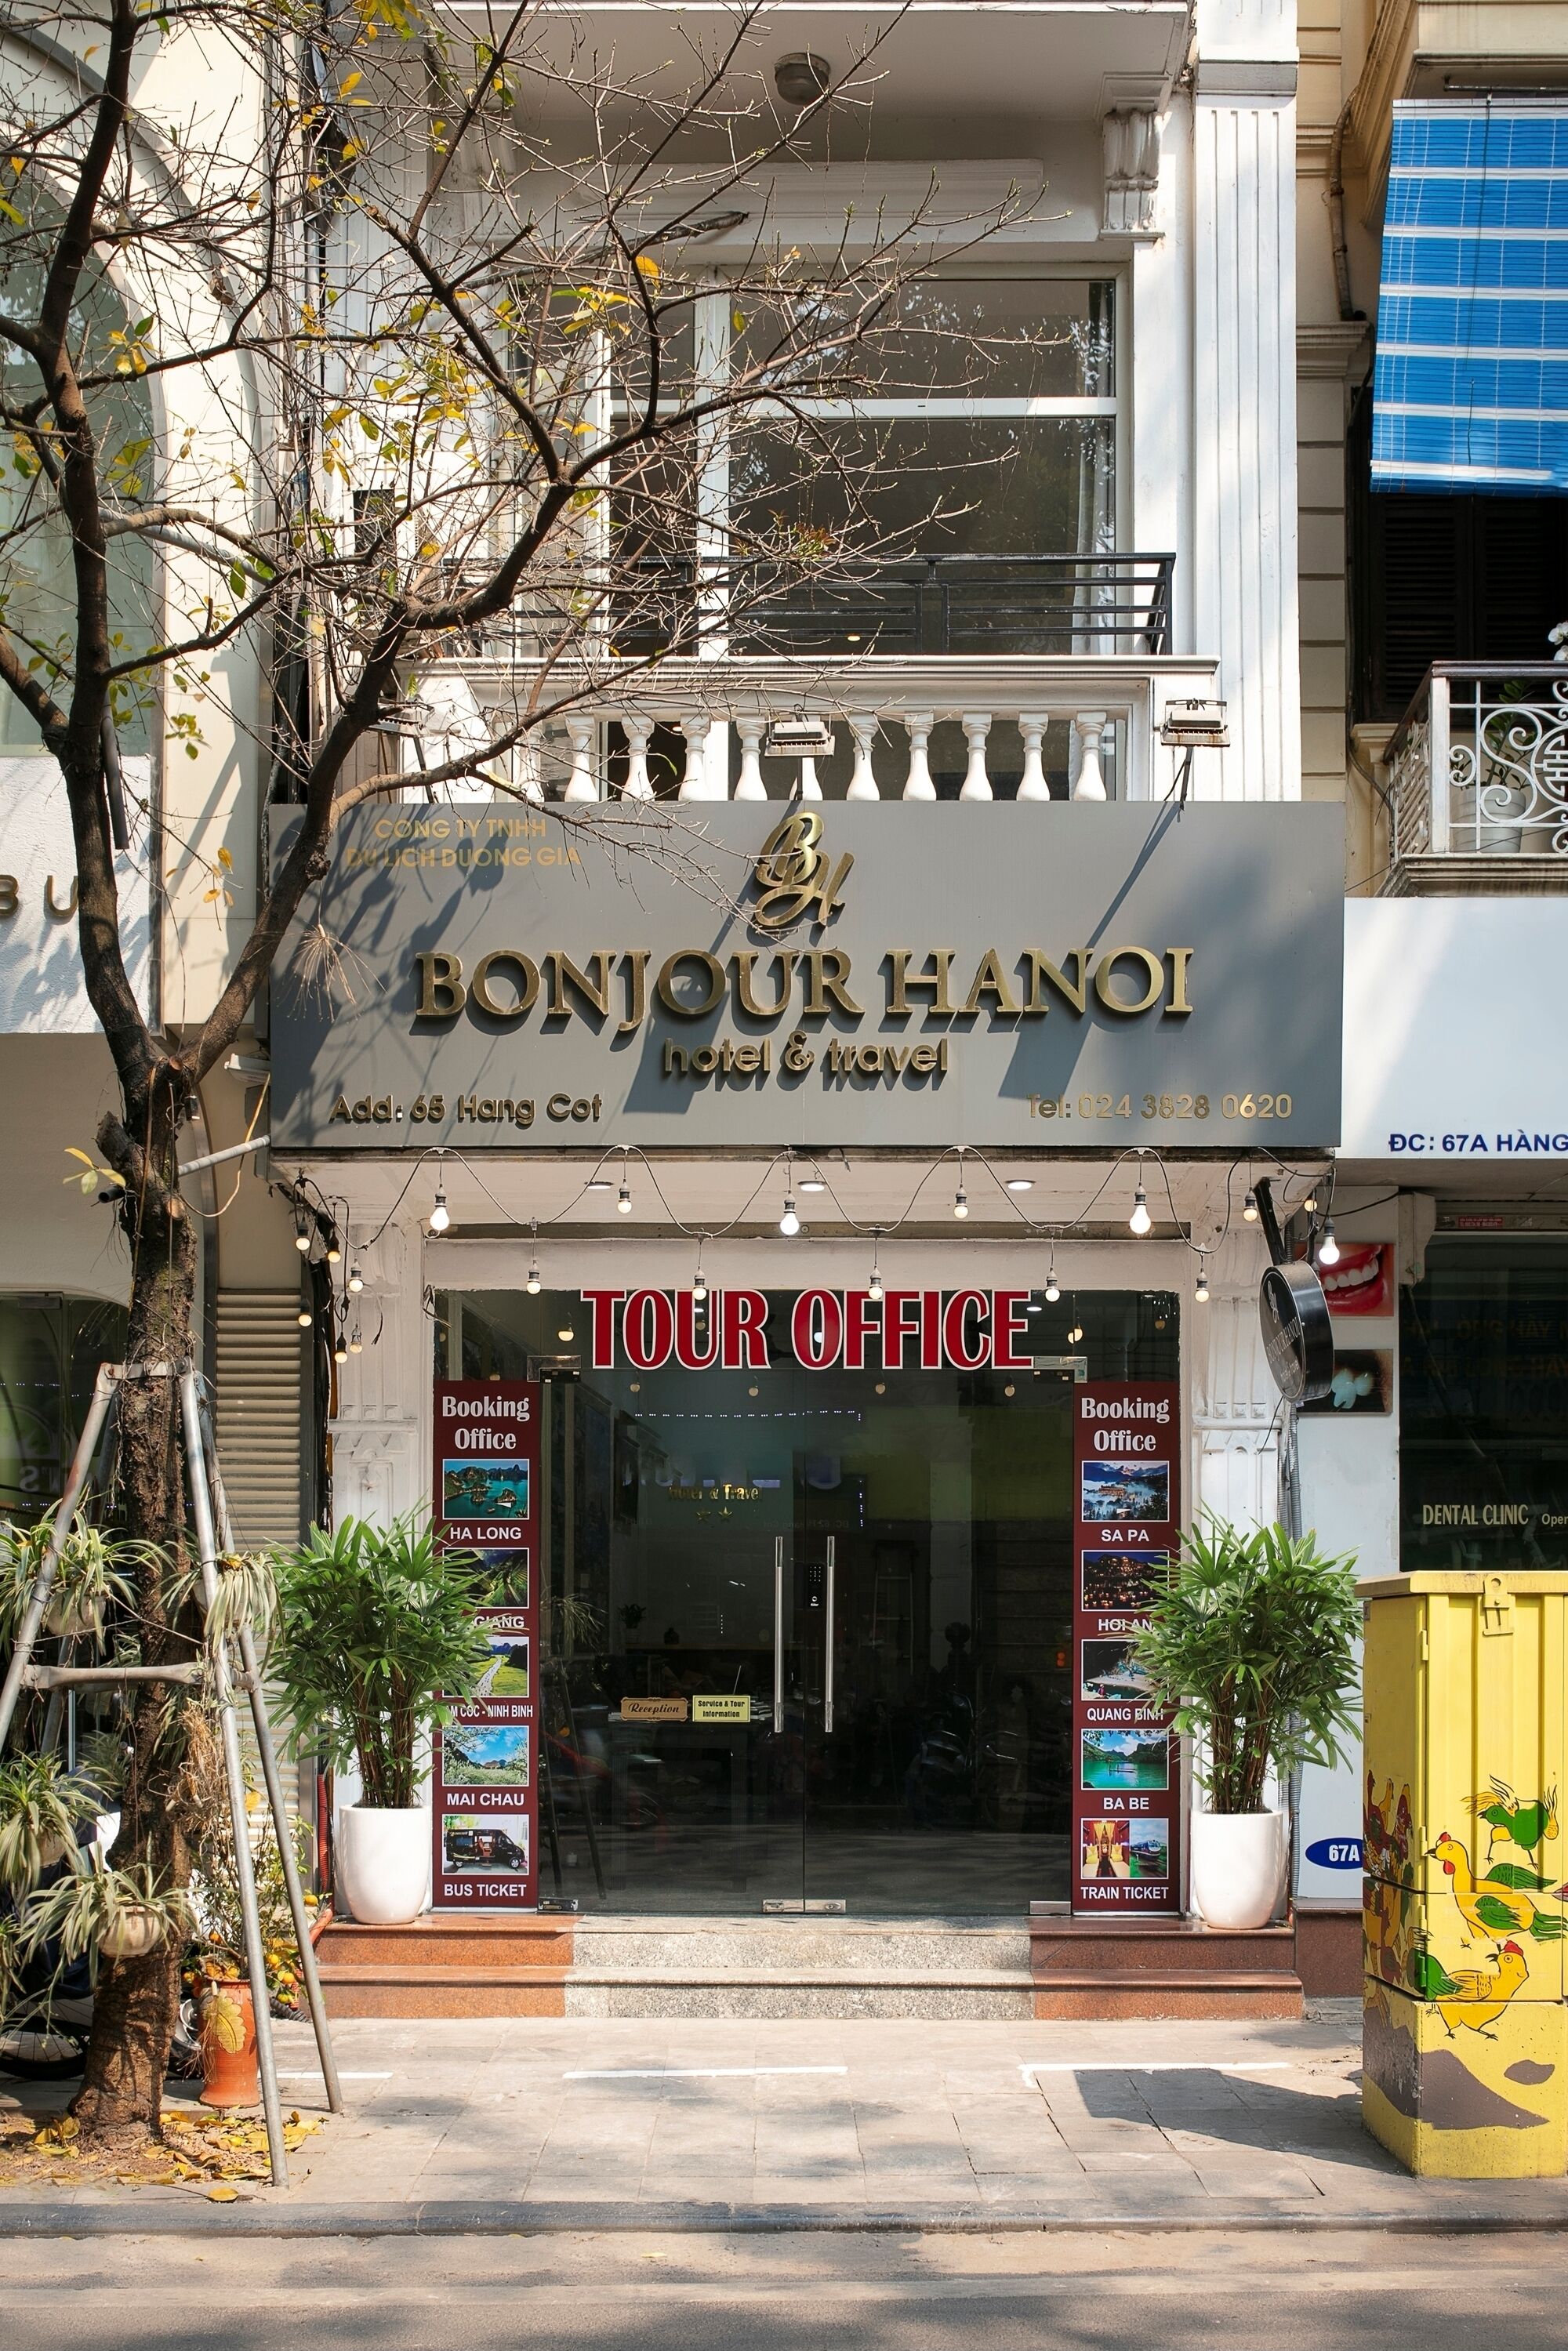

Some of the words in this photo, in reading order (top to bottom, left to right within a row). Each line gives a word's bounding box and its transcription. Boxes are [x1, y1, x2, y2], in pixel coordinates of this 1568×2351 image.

[485, 819, 546, 838] TNHH
[536, 847, 582, 867] GIA
[415, 949, 866, 1032] BONJOUR
[885, 947, 1194, 1014] HANOI
[663, 1037, 771, 1072] hotel
[784, 1030, 815, 1072] &
[829, 1037, 949, 1074] travel
[329, 1094, 403, 1123] Add:
[409, 1094, 445, 1121] 65
[458, 1094, 536, 1127] Hang
[547, 1094, 602, 1121] Cot
[1027, 1094, 1072, 1119] Tel:
[1078, 1094, 1133, 1119] 024
[1140, 1094, 1210, 1119] 3828
[1221, 1094, 1293, 1119] 0620
[1442, 1134, 1488, 1152] 67A
[1496, 1129, 1568, 1152] HÀNG
[580, 1288, 772, 1370] TOUR
[790, 1288, 1035, 1370] OFFICE
[442, 1395, 531, 1422] Booking
[1081, 1397, 1170, 1424] Booking
[455, 1428, 517, 1449] Office
[1094, 1430, 1156, 1451] Office
[1423, 1504, 1478, 1525] DENTAL
[1483, 1504, 1529, 1525] CLINIC
[450, 1527, 472, 1540] HA
[477, 1527, 521, 1540] LONG
[1101, 1529, 1123, 1542] SA
[1127, 1529, 1149, 1542] PA
[1098, 1619, 1126, 1631] HOI
[487, 1704, 509, 1718] NINH
[511, 1704, 533, 1718] BINH
[628, 1702, 680, 1714] Reception
[1087, 1707, 1131, 1721] QUANG
[447, 1794, 474, 1805] MAI
[480, 1793, 524, 1806] CHAU
[1103, 1798, 1125, 1810] BA
[1129, 1798, 1149, 1810] BE
[1329, 1844, 1359, 1862] 67A
[445, 1885, 473, 1896] BUS
[477, 1885, 527, 1896] TICKET
[1081, 1887, 1119, 1899] TRAIN
[1123, 1887, 1169, 1899] TICKET
